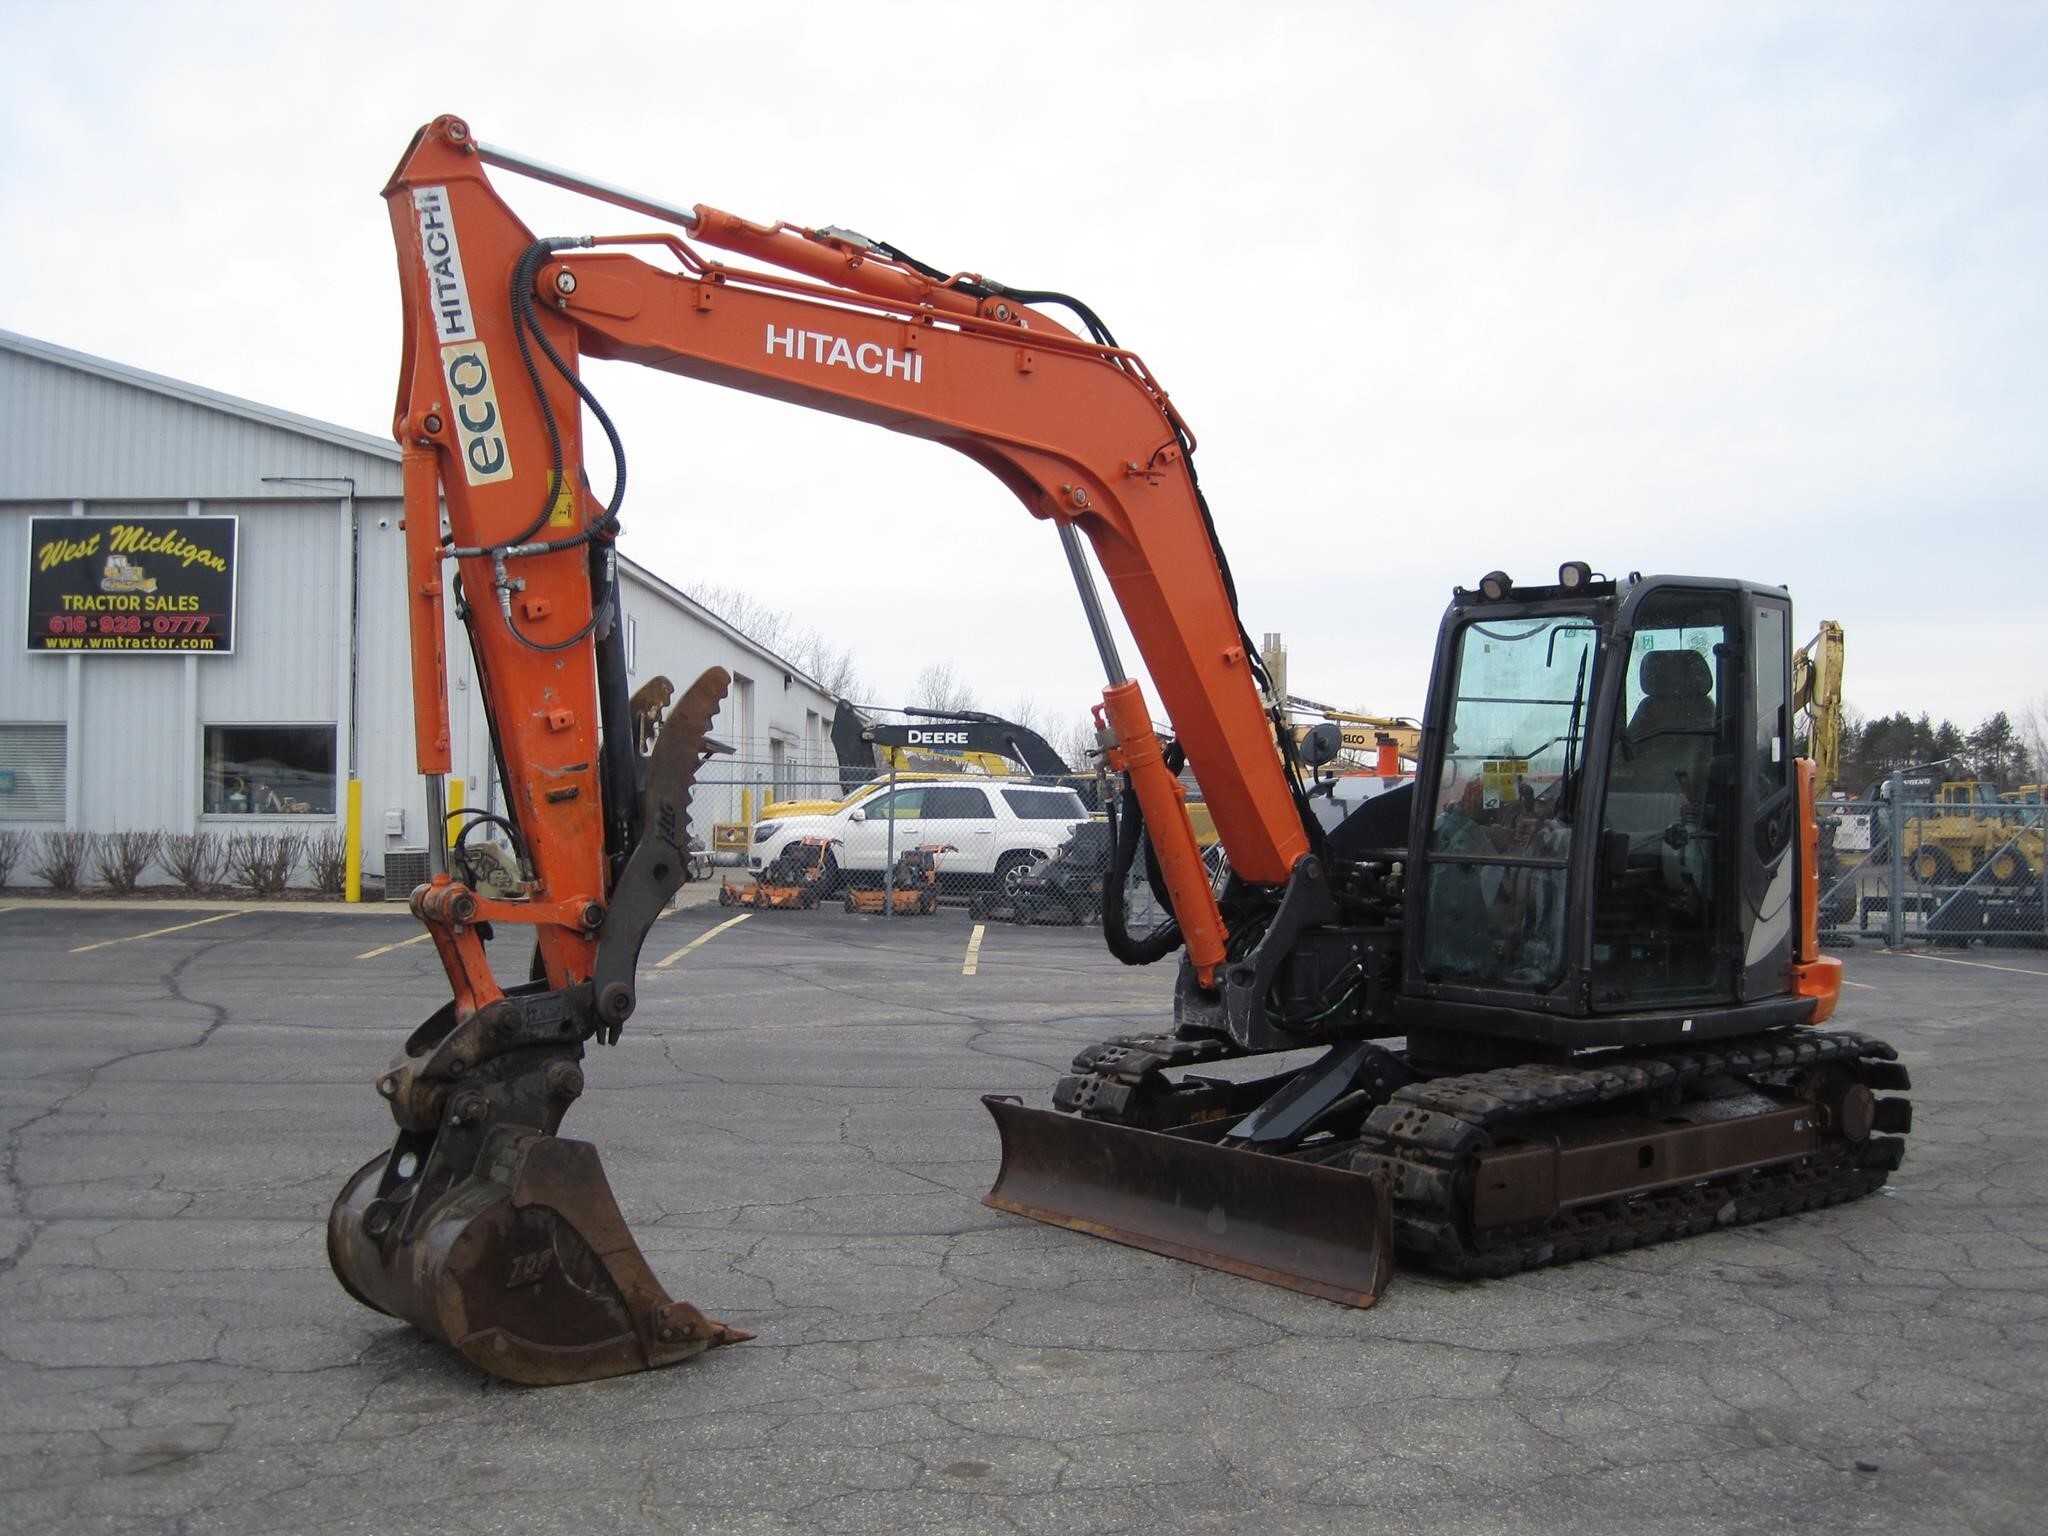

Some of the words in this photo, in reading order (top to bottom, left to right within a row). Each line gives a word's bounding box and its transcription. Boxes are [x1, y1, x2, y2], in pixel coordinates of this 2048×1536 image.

[419, 191, 466, 335] HITACHI
[766, 324, 923, 384] HITACHI
[449, 351, 505, 475] eco
[39, 534, 101, 571] West
[110, 525, 227, 573] Michigan
[62, 595, 140, 611] TRACTOR
[145, 596, 200, 611] SALES
[46, 637, 214, 649] www.wmtractor.com
[908, 730, 969, 744] DEERE
